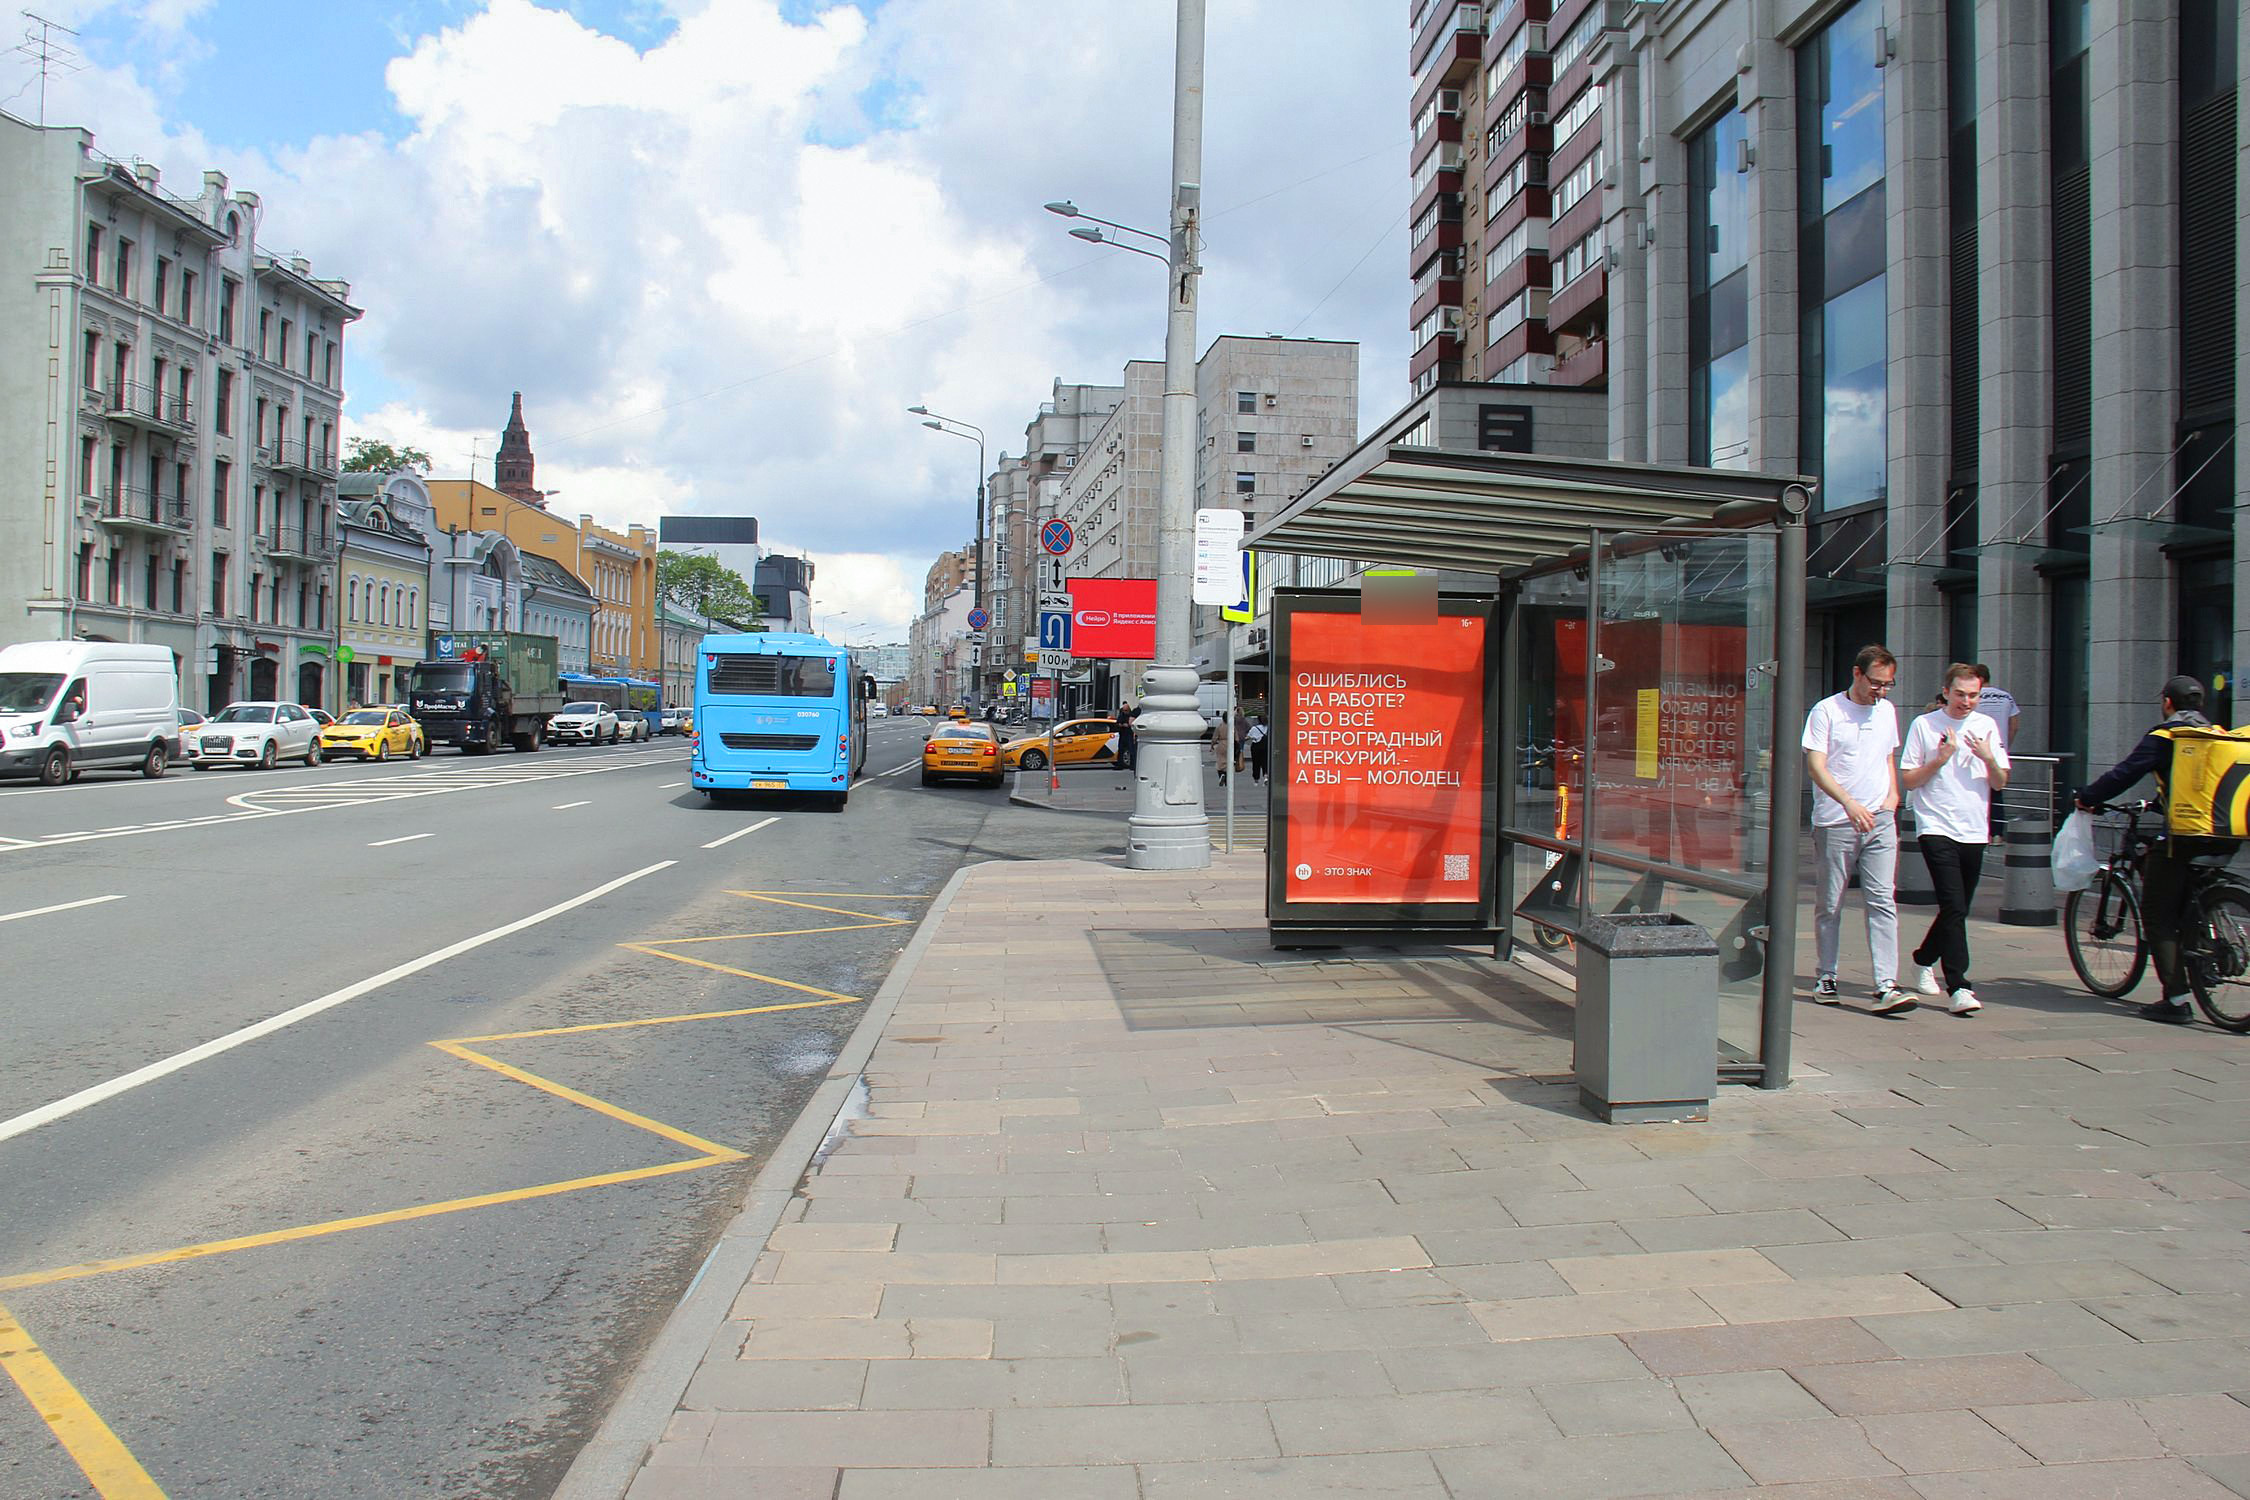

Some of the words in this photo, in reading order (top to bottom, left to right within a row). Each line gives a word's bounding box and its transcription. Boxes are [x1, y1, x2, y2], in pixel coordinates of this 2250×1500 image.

[1461, 619, 1473, 628] 16+
[1296, 672, 1407, 689] ОШИБЛИСЬ
[1296, 692, 1324, 707] НА
[1328, 692, 1405, 708] РАБОТЕ?
[1296, 711, 1333, 727] ЭТО
[1338, 709, 1375, 727] ВСЁ
[1296, 730, 1443, 749] РЕТРОГРАДНЫЙ
[1296, 748, 1401, 766] МЕРКУРИЙ.
[1296, 770, 1309, 785] А
[1314, 770, 1341, 785] ВЫ
[1367, 770, 1461, 788] МОЛОДЕЦ
[1298, 867, 1309, 876] hh
[1324, 867, 1345, 877] ЭТО
[1347, 867, 1373, 877] ЗНАК
